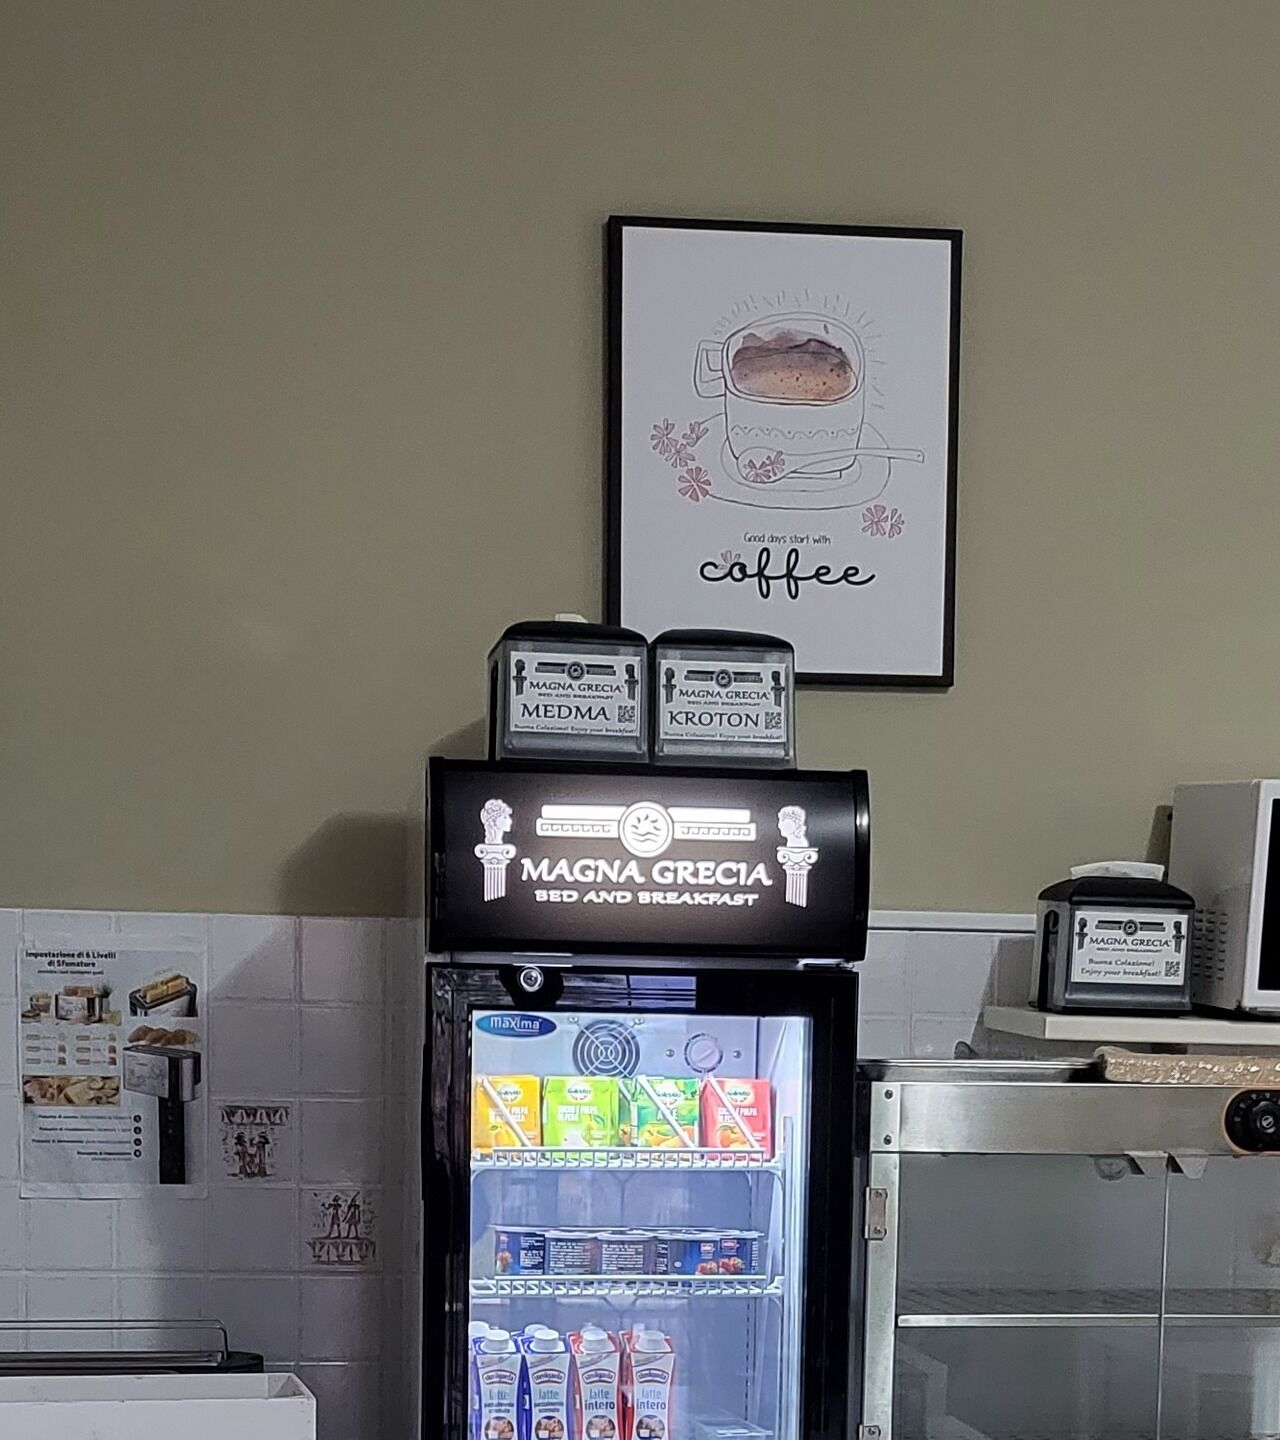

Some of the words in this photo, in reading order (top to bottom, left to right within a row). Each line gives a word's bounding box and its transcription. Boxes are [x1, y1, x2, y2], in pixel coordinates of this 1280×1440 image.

[744, 532, 765, 543] Good
[767, 534, 787, 545] days
[789, 534, 809, 544] start
[812, 534, 831, 545] with
[699, 547, 876, 600] coffee
[529, 681, 575, 692] MAGNA
[578, 683, 623, 693] GRECIA
[679, 689, 723, 699] MAGNA
[725, 690, 769, 701] GRECIA
[521, 703, 611, 721] MEDMA
[668, 711, 760, 728] KROTON
[520, 857, 645, 884] MAGNA
[652, 859, 773, 887] GRECIA
[535, 889, 578, 903] BED
[583, 890, 633, 905] AND
[637, 891, 759, 907] BREAKFAST
[1089, 936, 1128, 946] MAGNA
[1131, 937, 1170, 948] GRECIA
[25, 951, 75, 961] Impostazione
[77, 951, 84, 960] di
[92, 951, 117, 960] Livelli
[1088, 958, 1112, 966] Buona
[47, 960, 55, 968] di
[56, 960, 96, 968] Sfumature
[1081, 968, 1103, 977] Enjoy
[1123, 968, 1162, 978] breakfast!
[490, 1015, 540, 1032] maxima
[657, 1107, 678, 1120] AE
[539, 1389, 559, 1400] latte
[589, 1388, 610, 1400] latte
[642, 1388, 662, 1398] latte
[585, 1400, 615, 1410] intero
[636, 1400, 667, 1410] intero
